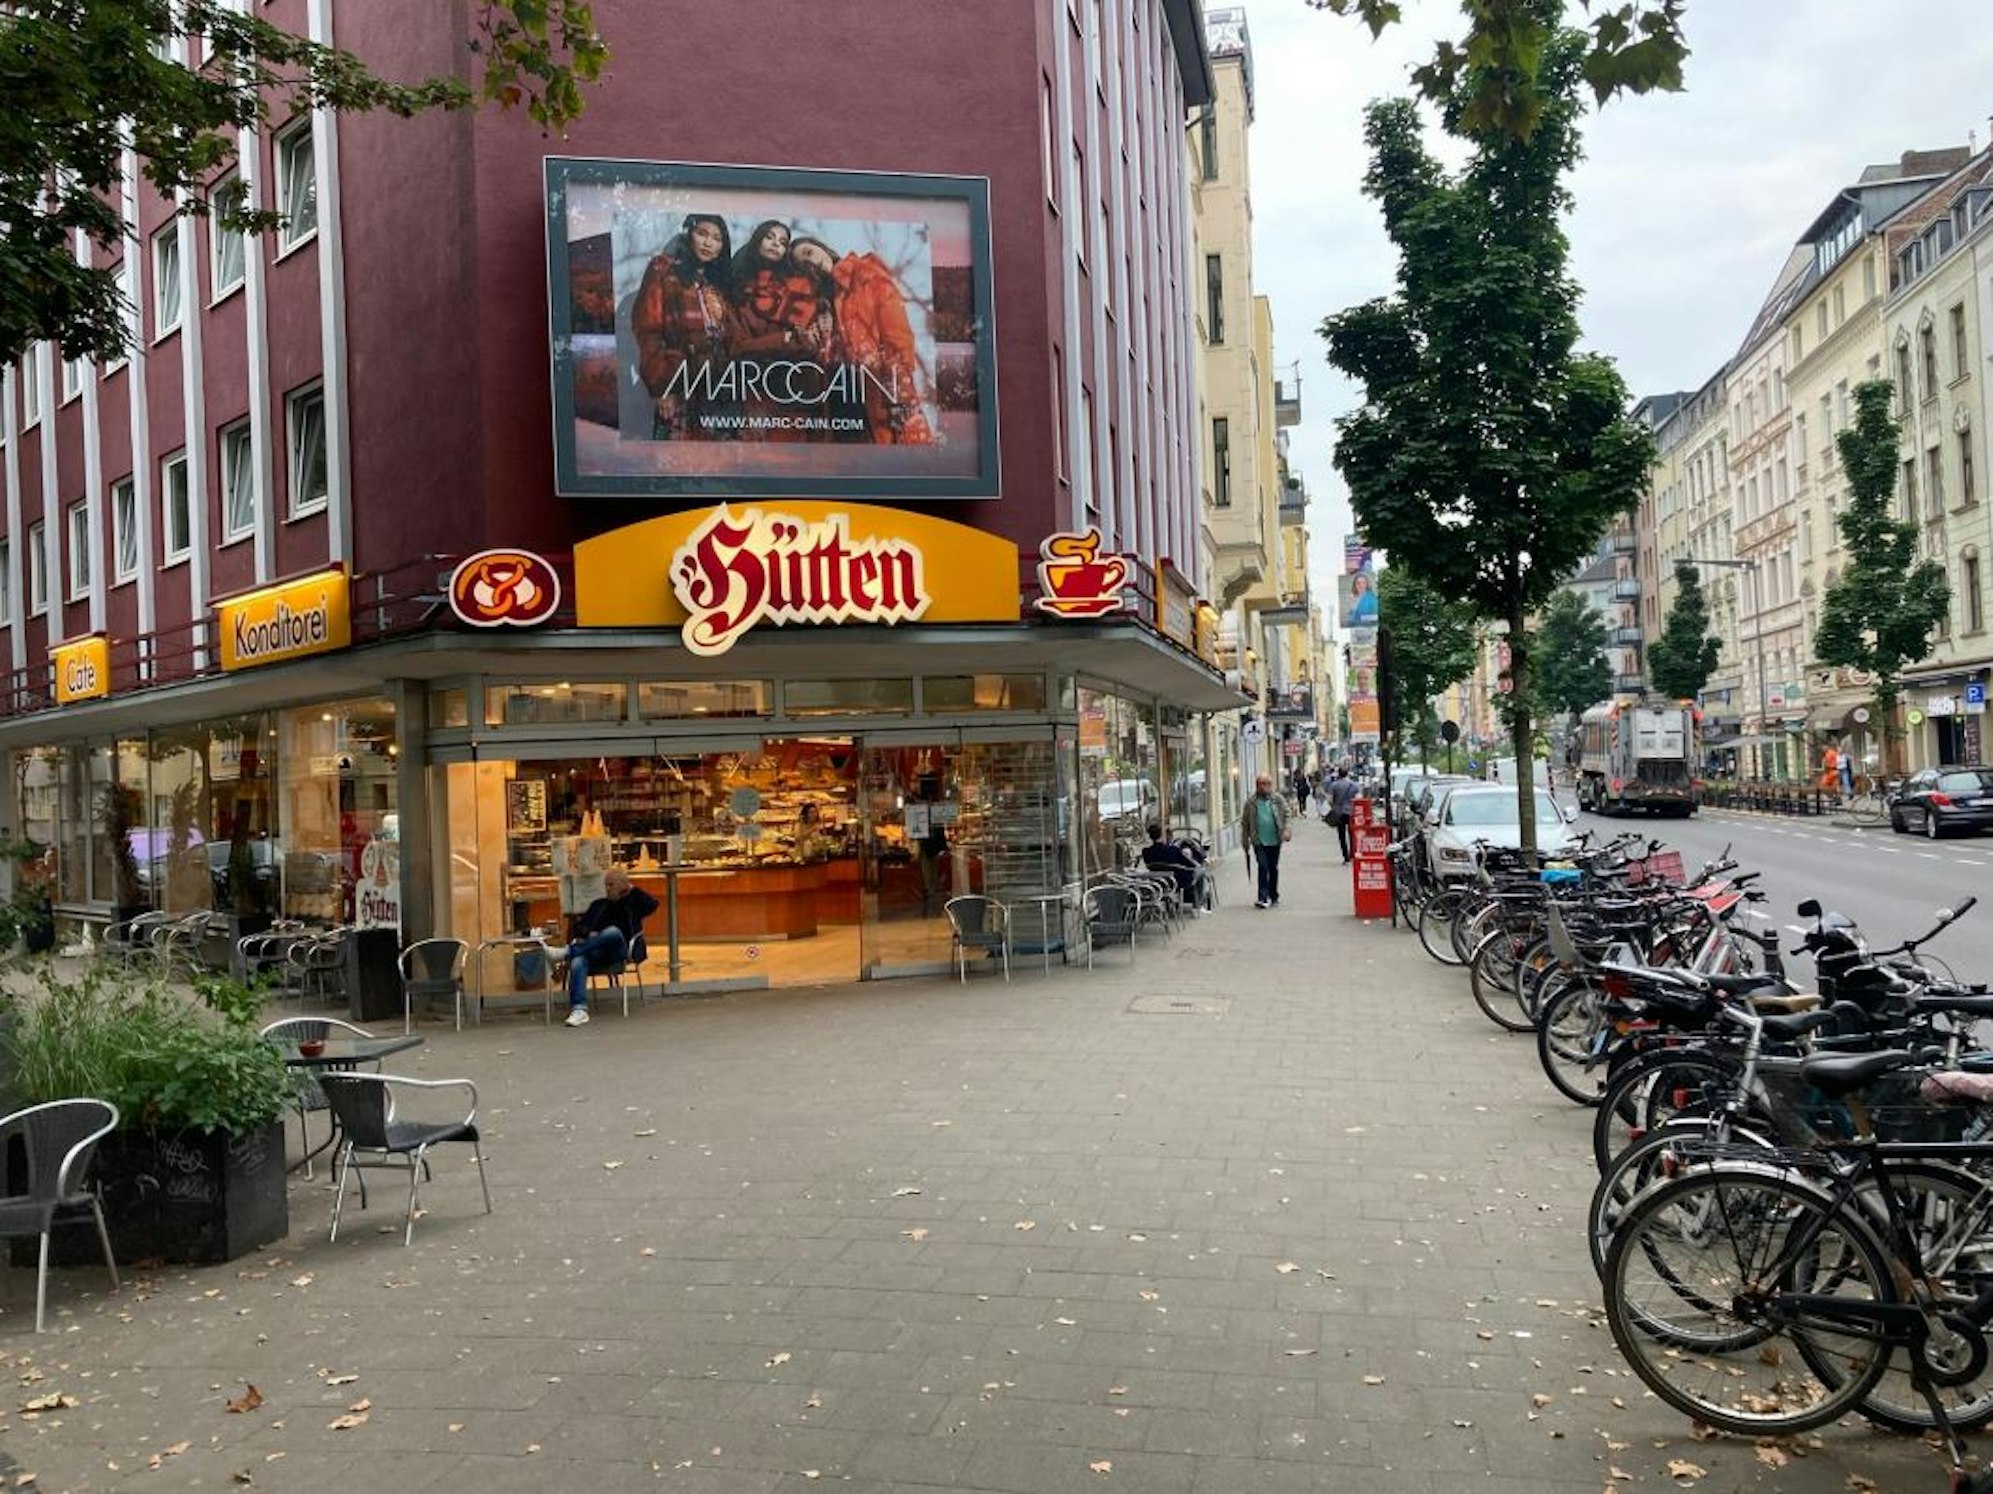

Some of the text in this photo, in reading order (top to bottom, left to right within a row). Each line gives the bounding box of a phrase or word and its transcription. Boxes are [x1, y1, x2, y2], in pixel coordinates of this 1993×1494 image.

[700, 415, 864, 431] WWW.MARC-CAIN.COM
[680, 517, 922, 647] Hütten
[234, 594, 328, 658] Konditorei
